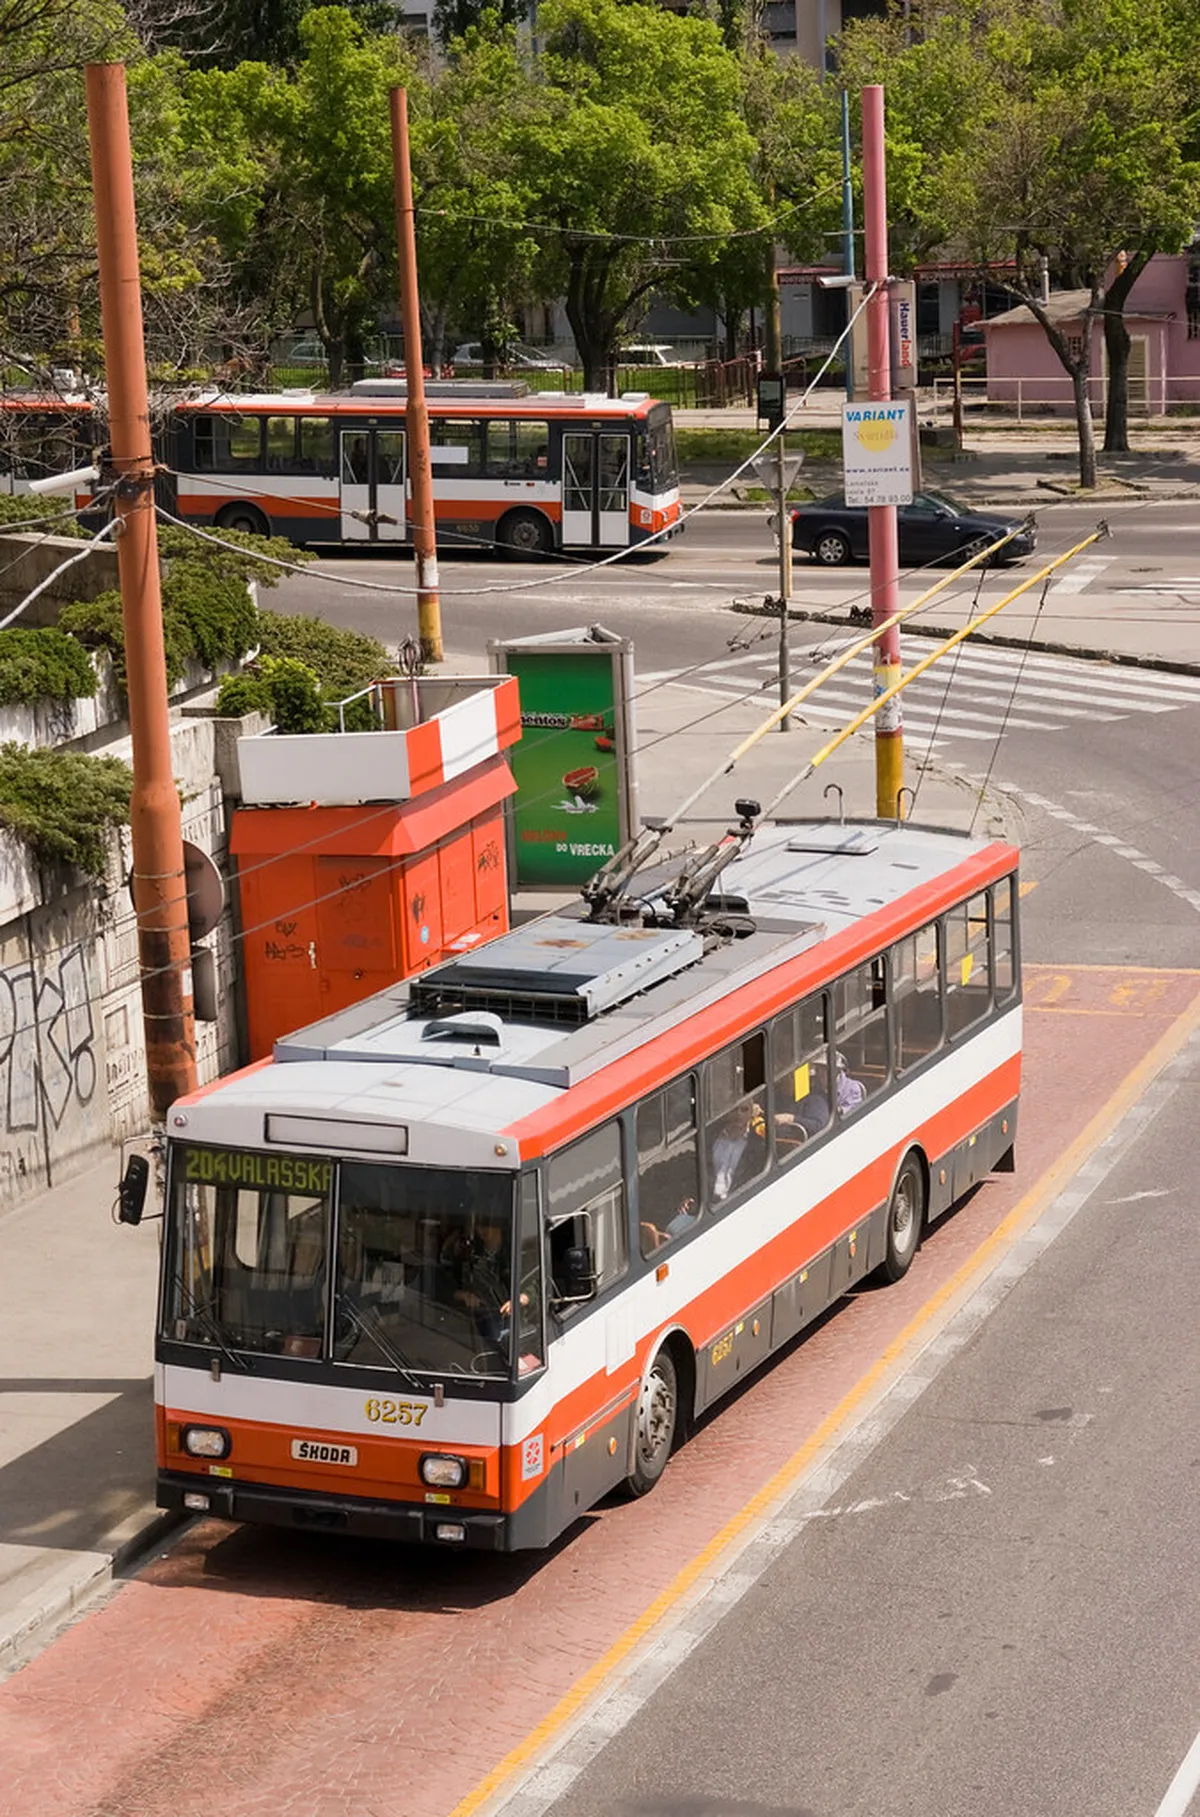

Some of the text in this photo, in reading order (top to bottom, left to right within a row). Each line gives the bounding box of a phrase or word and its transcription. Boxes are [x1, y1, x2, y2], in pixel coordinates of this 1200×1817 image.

[899, 302, 912, 368] Hauerland
[846, 409, 905, 422] VARIANT
[556, 843, 615, 857] DO VRECKA
[365, 1399, 428, 1426] 6257
[299, 1442, 351, 1463] ŠKODA
